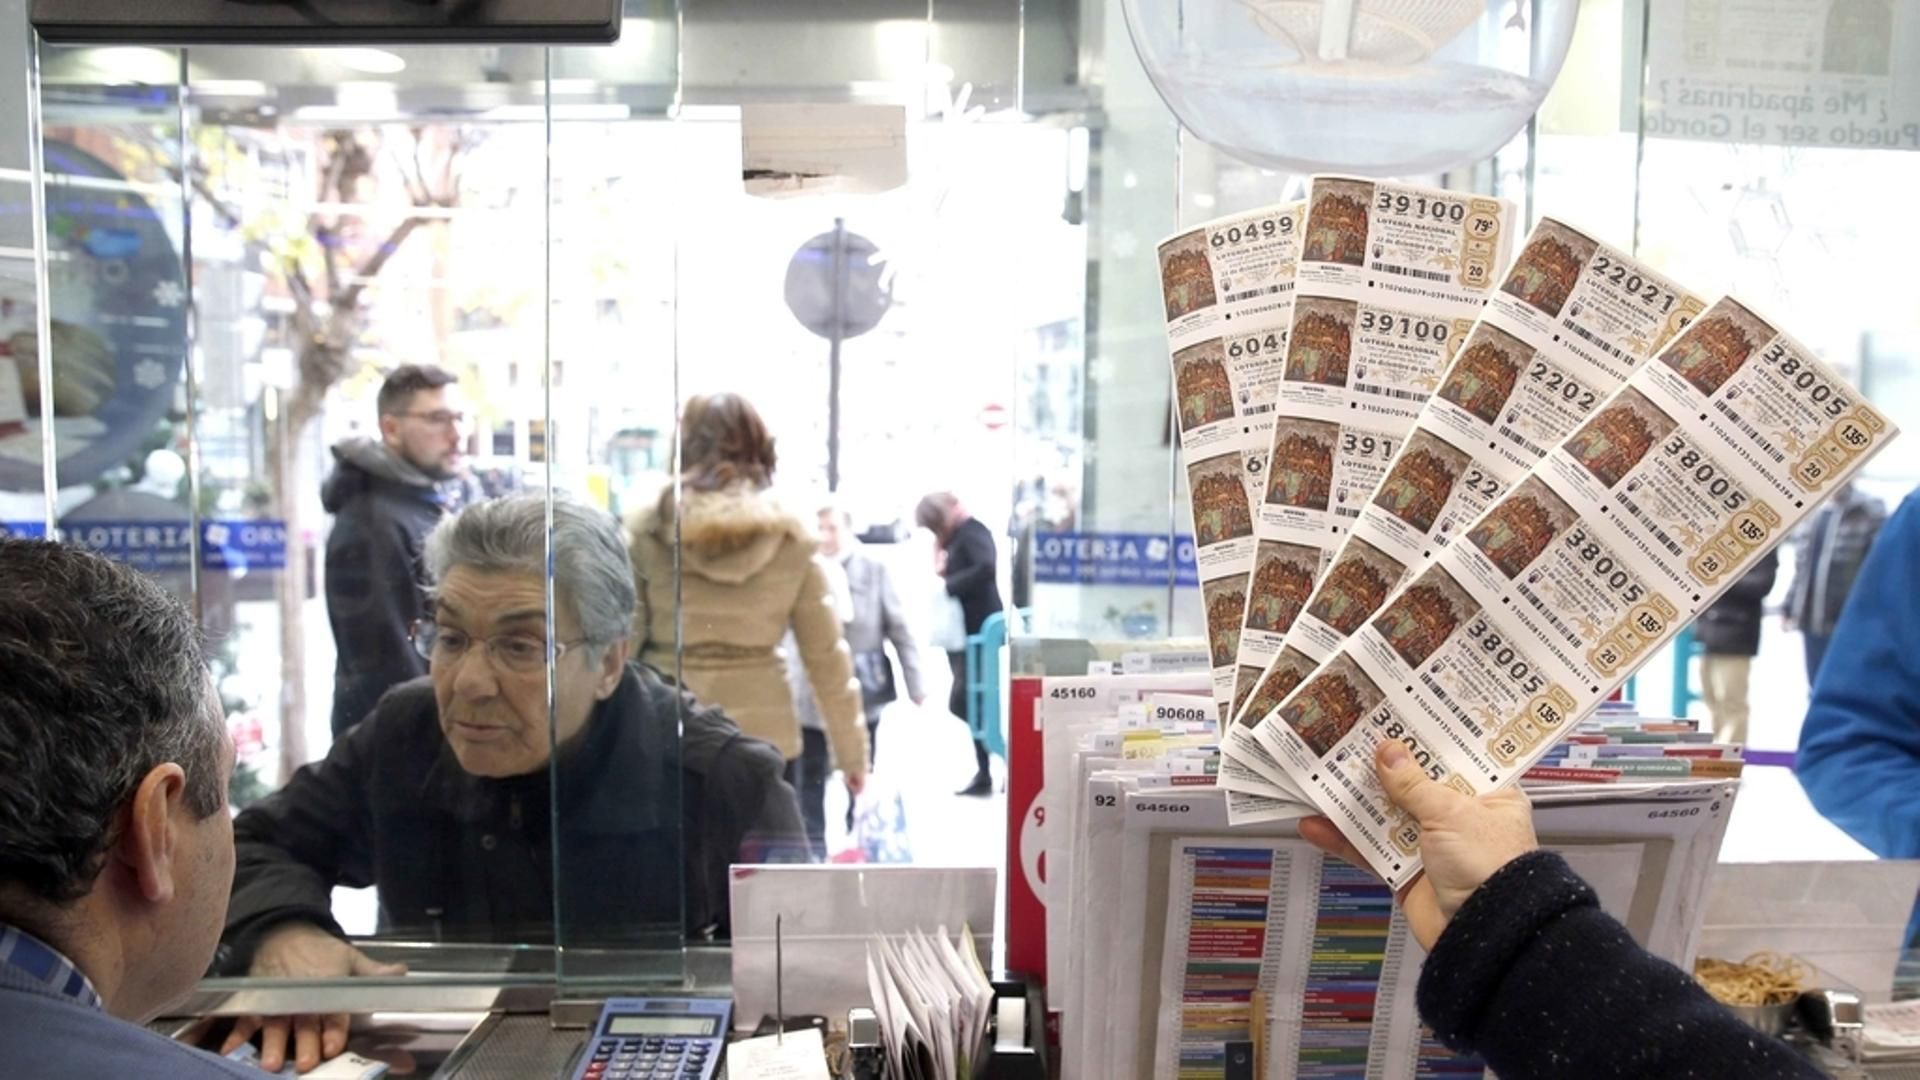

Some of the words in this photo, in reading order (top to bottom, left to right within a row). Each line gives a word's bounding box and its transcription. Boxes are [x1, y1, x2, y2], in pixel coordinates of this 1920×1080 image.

[1376, 191, 1465, 221] 39100
[1209, 214, 1294, 248] 60499
[1414, 223, 1456, 235] NACIONAL
[1468, 265, 1483, 276] 20
[1591, 255, 1675, 312] 22021
[1618, 297, 1659, 324] NACIONAL
[1360, 311, 1448, 341] 39100
[1397, 343, 1439, 356] NACIONAL
[1528, 360, 1598, 410] 2202
[1762, 342, 1849, 419] 38005
[1783, 392, 1823, 426] NACIONAL
[1343, 433, 1392, 457] 391
[1661, 433, 1748, 513] 38005
[1803, 461, 1822, 479] 20
[1464, 468, 1507, 503] 22
[1682, 484, 1722, 521] NACIONAL
[73, 527, 191, 548] LOTERIA
[1034, 538, 1139, 560] LOTERIA
[1562, 526, 1647, 605] 38005
[1701, 555, 1719, 572] 20
[1582, 577, 1621, 613] NACIONAL
[1465, 617, 1546, 696] 38005
[1600, 648, 1617, 665] 20
[1051, 687, 1096, 700] 45160
[1483, 667, 1520, 703] NACIONAL
[1157, 706, 1205, 722] 90608
[1500, 738, 1517, 755] 20
[1095, 795, 1117, 807] 92
[1136, 803, 1190, 813] 64560
[1648, 807, 1700, 819] 64560
[1401, 826, 1418, 844] 20
